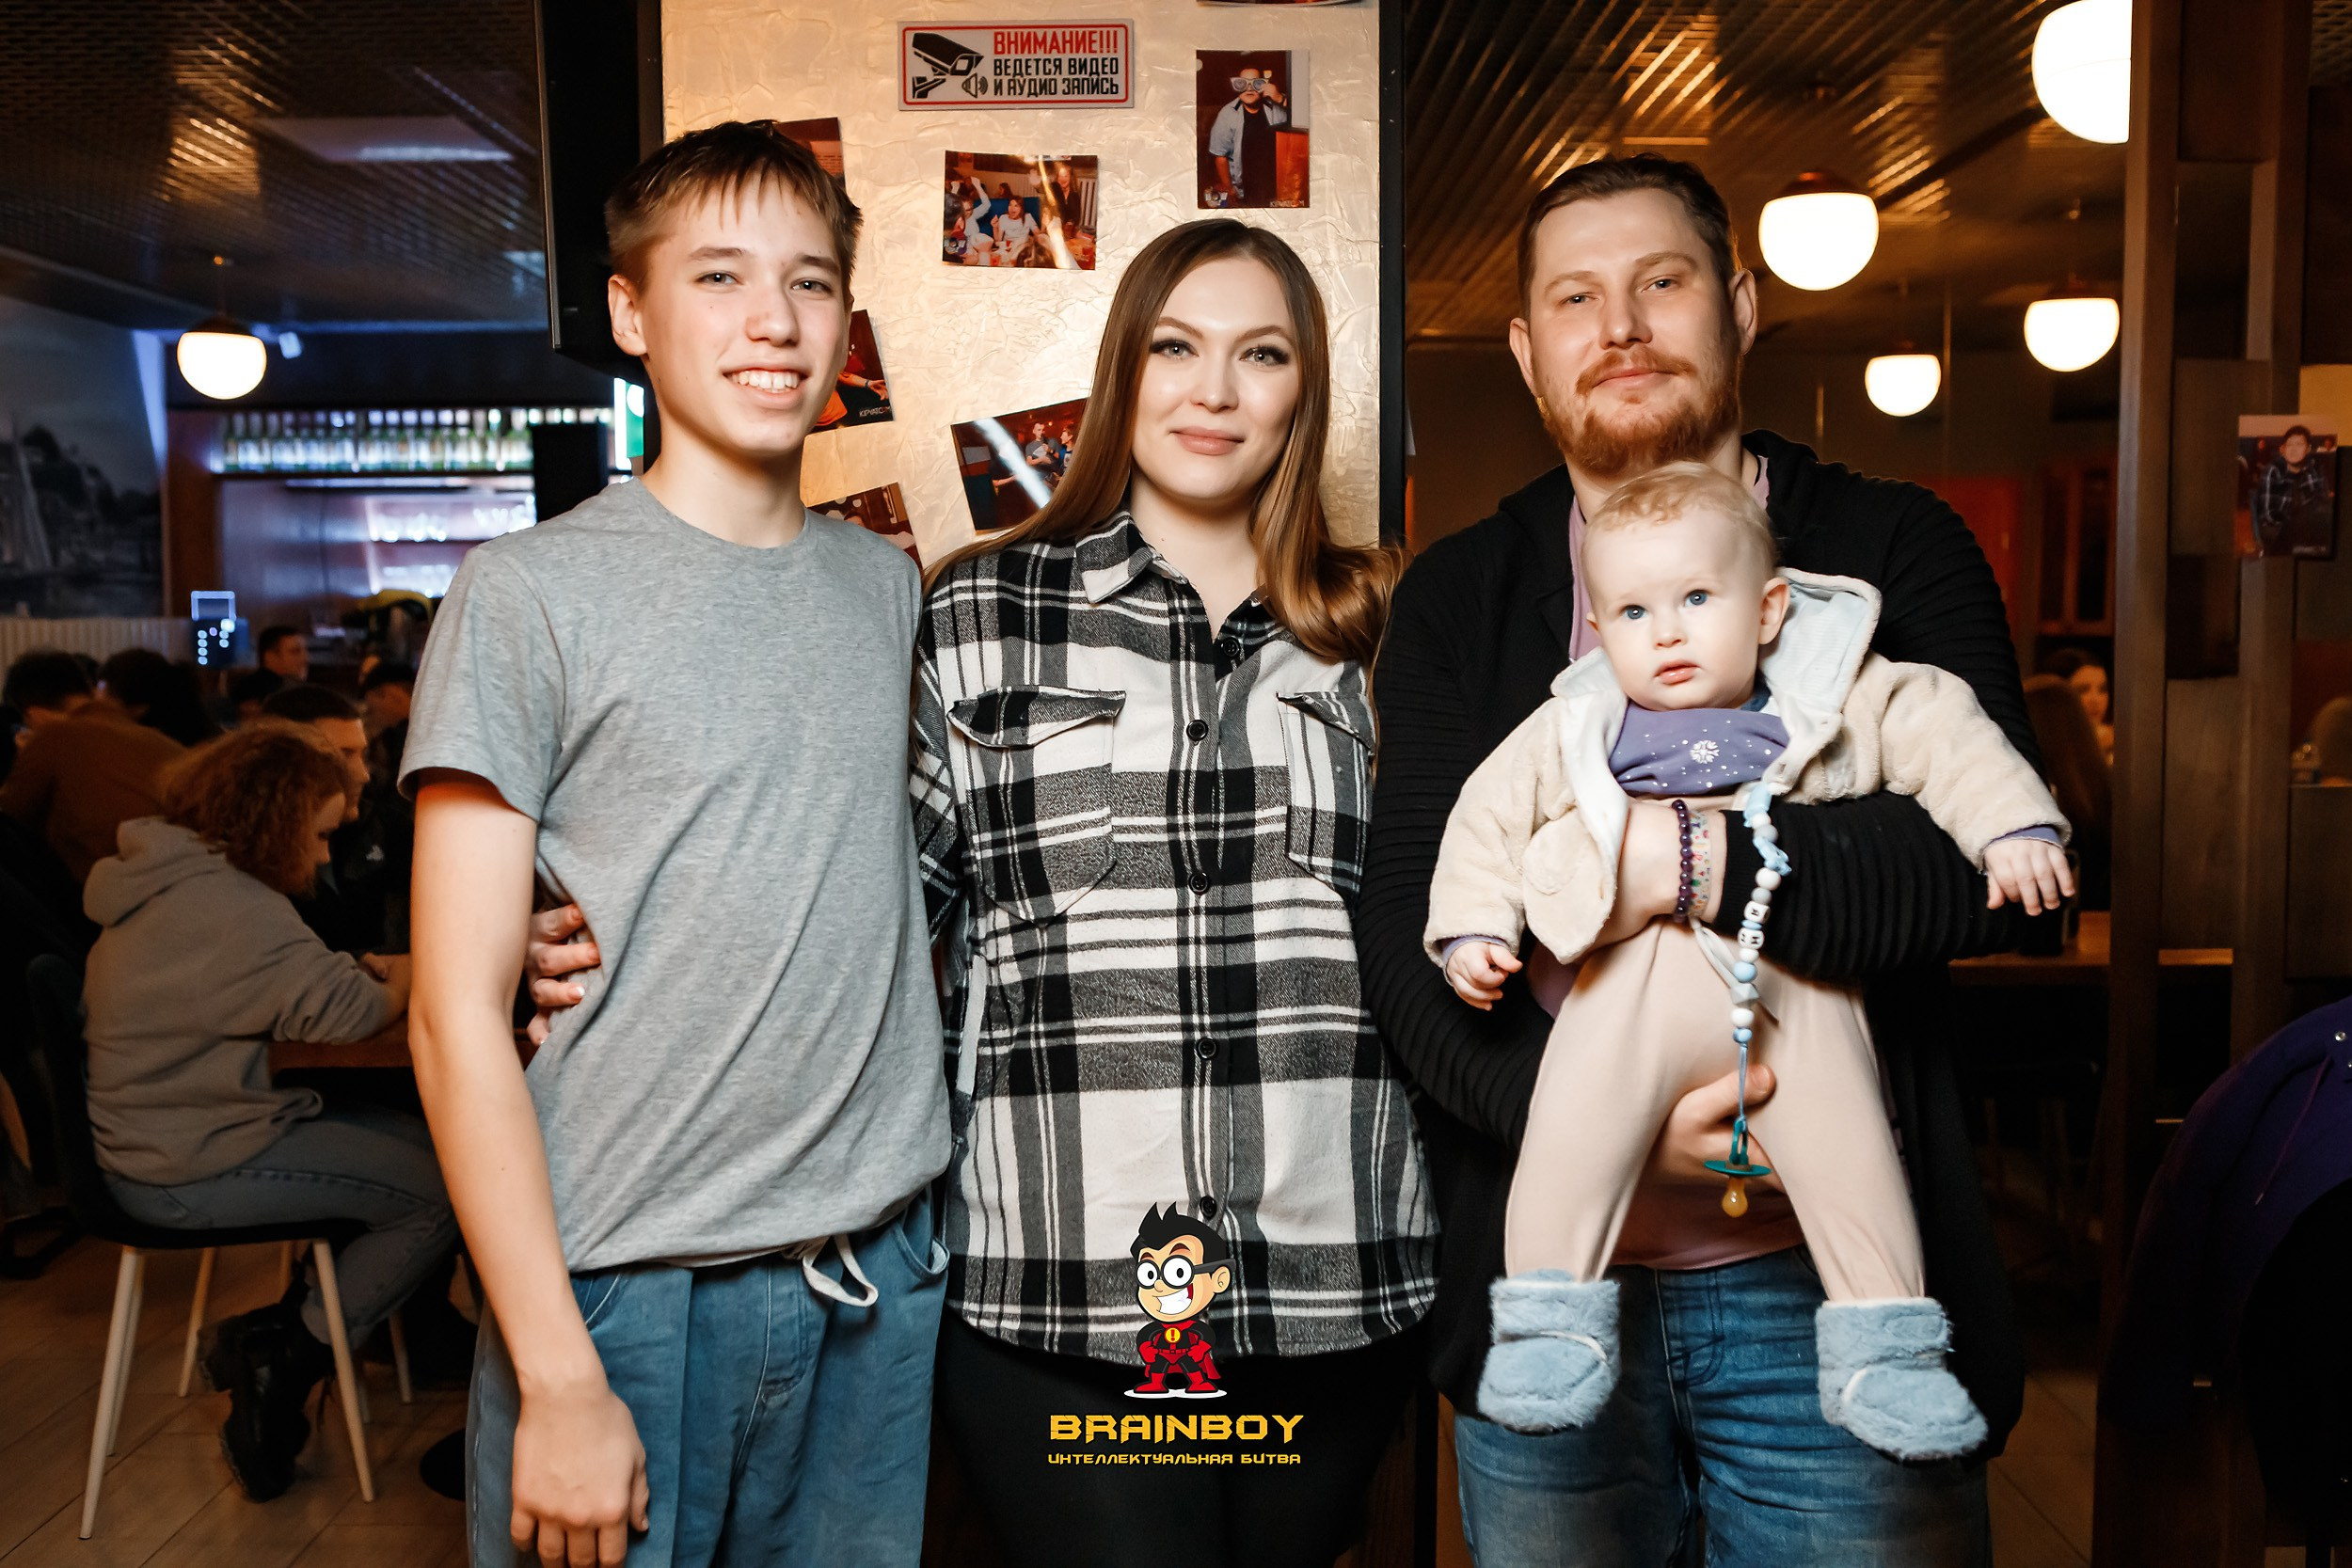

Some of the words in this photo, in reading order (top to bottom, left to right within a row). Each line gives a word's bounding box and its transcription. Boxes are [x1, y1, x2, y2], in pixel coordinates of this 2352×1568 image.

[993, 30, 1118, 55] ВНИМАНИЕ!!!
[993, 58, 1062, 77] ВЕДЕТСЯ
[1068, 56, 1119, 77] ВИДЕО
[993, 78, 1003, 96] И
[1008, 77, 1057, 98] АУДИО
[1062, 77, 1119, 95] ЗАПИСЬ
